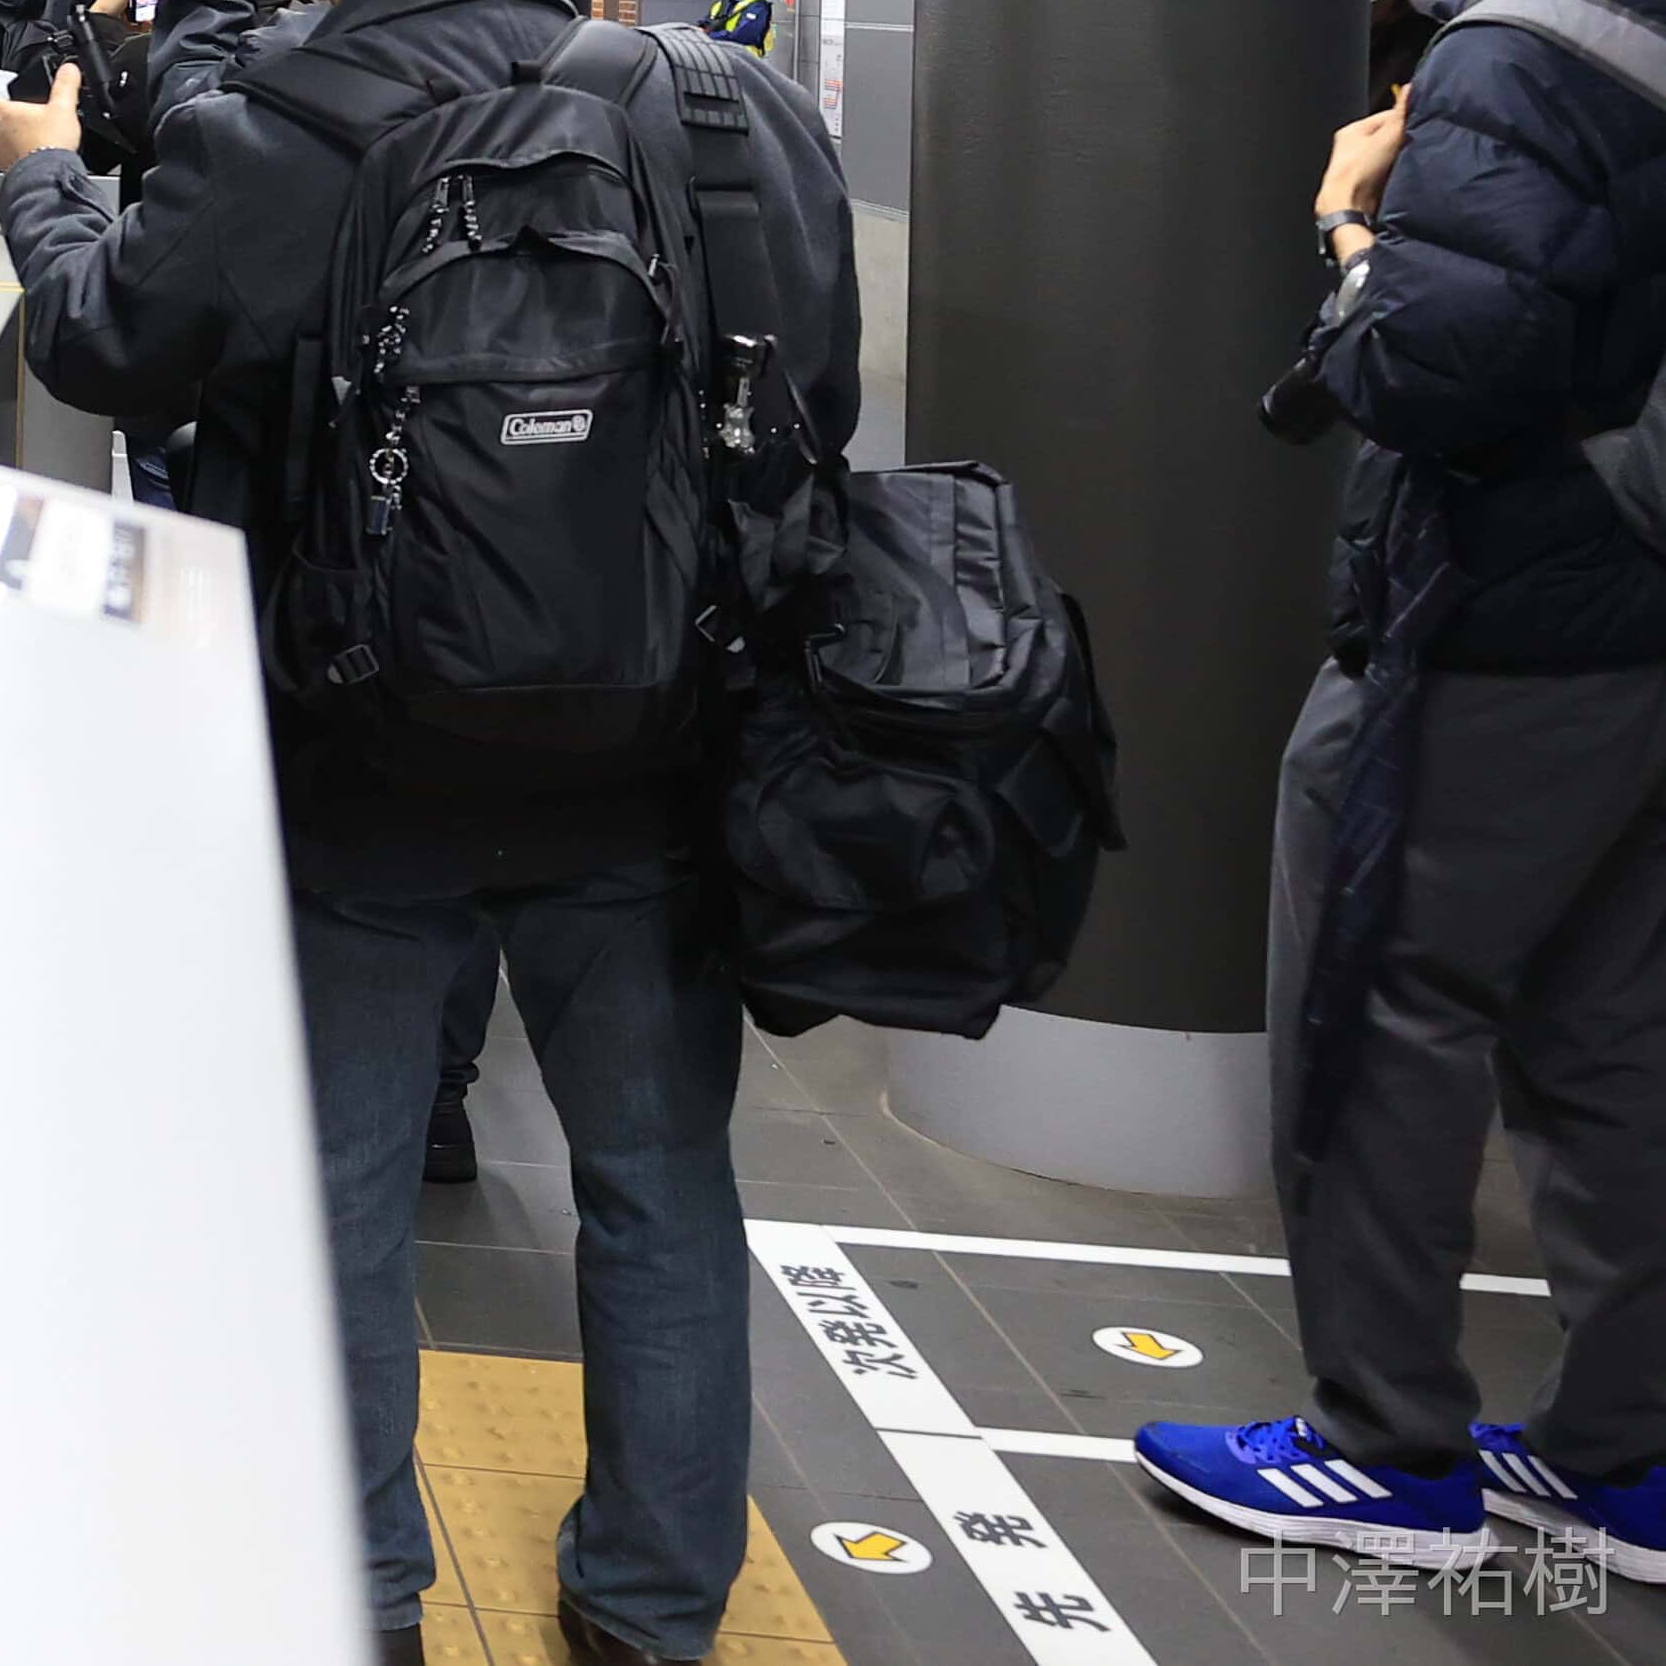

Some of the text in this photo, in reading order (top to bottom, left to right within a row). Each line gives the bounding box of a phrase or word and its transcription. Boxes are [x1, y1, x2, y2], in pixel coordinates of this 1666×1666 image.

[509, 417, 573, 436] Coleman
[779, 1263, 918, 1382] 次発以降
